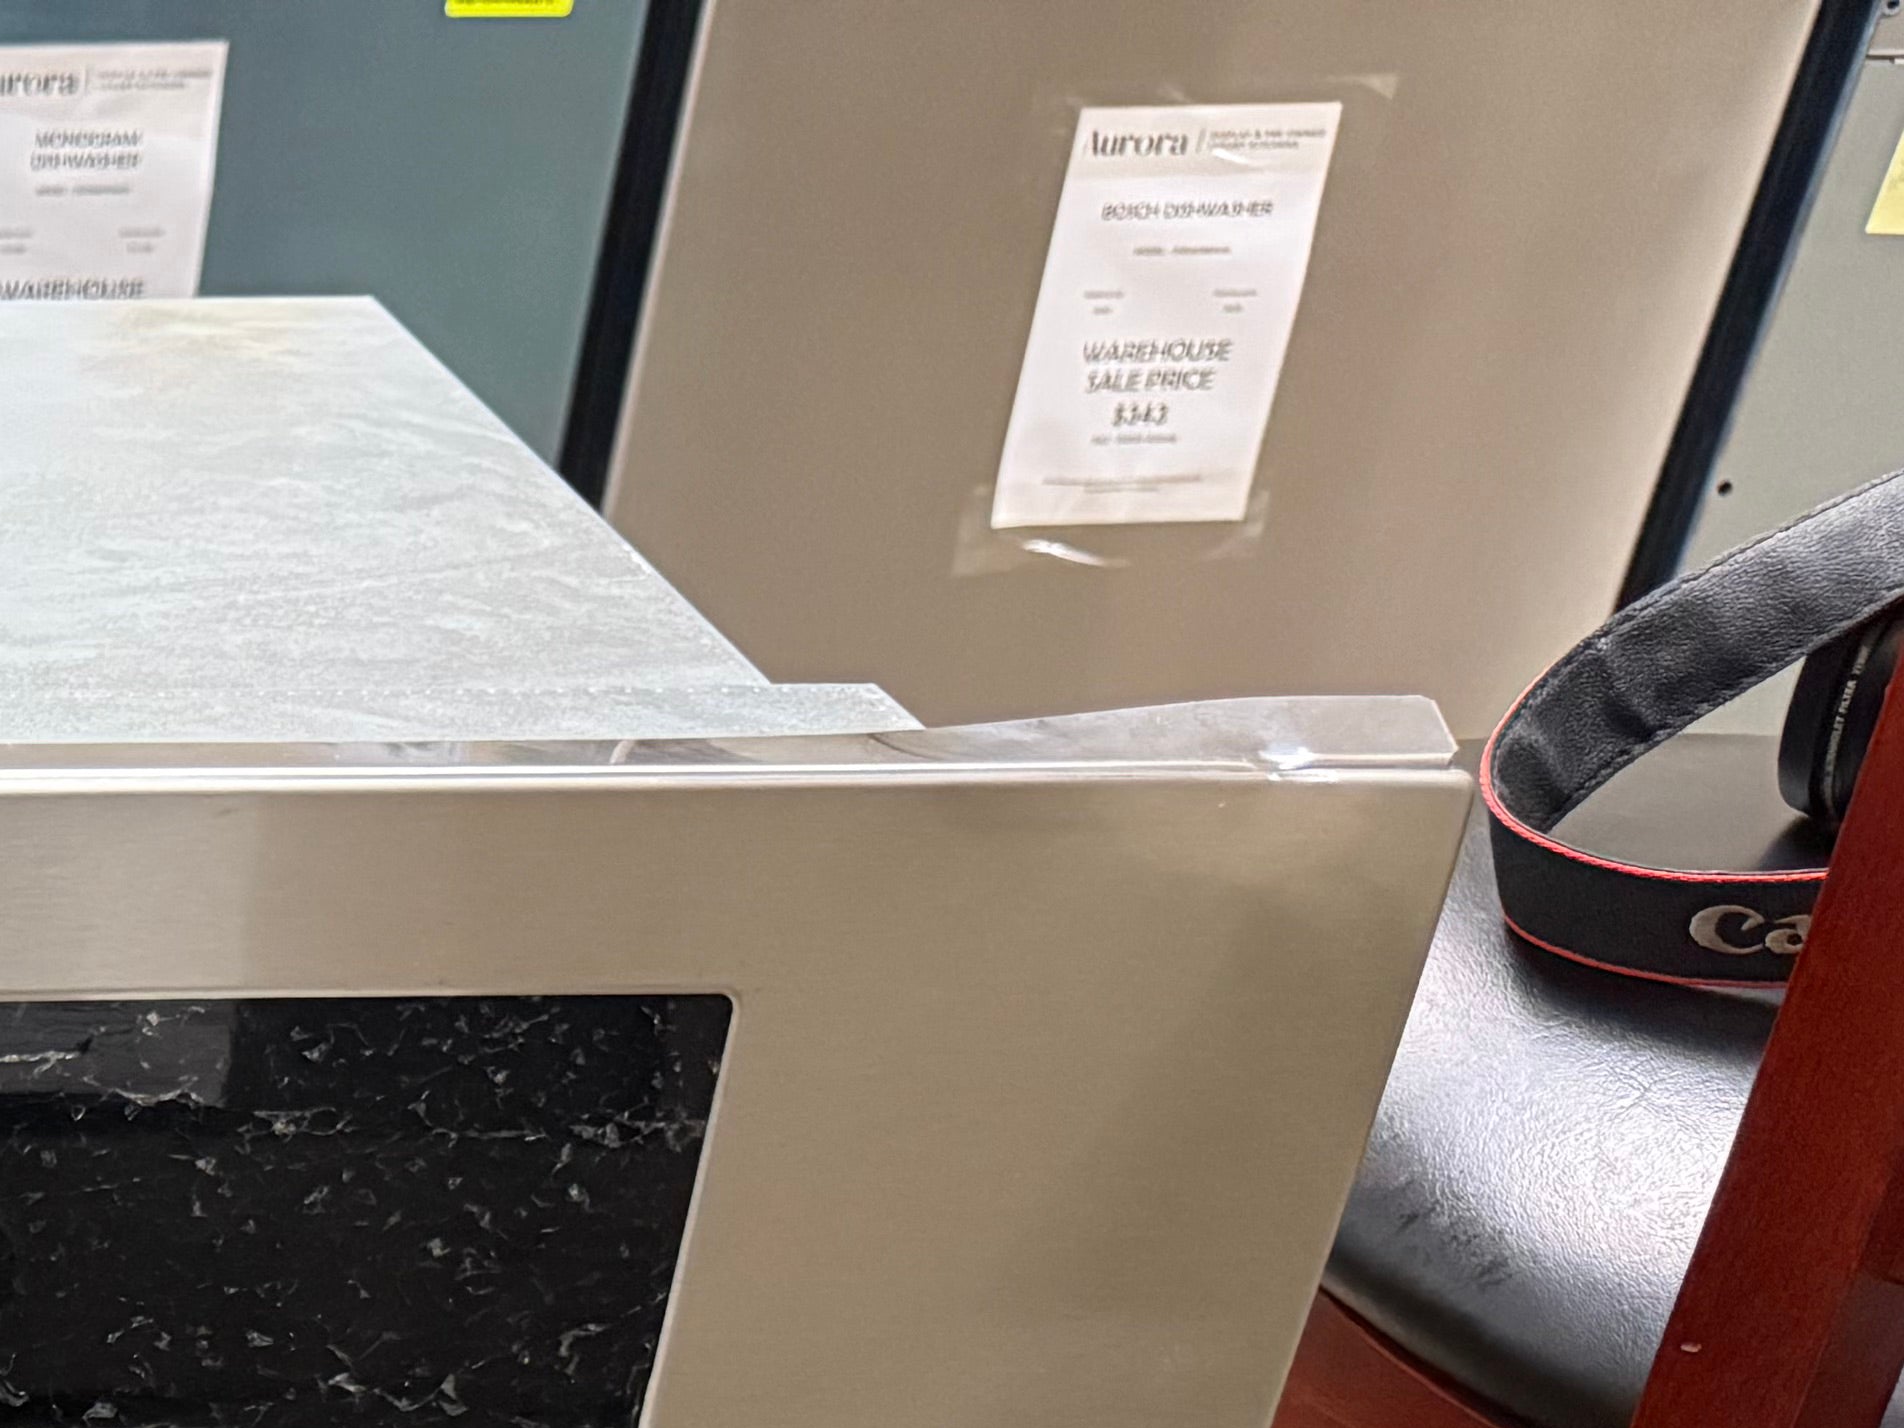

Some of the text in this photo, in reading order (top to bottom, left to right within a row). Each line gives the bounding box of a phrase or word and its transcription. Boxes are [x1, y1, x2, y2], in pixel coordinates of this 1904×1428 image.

[1083, 339, 1233, 363] WAREHOUSE
[1086, 367, 1215, 394] SALE PRICE
